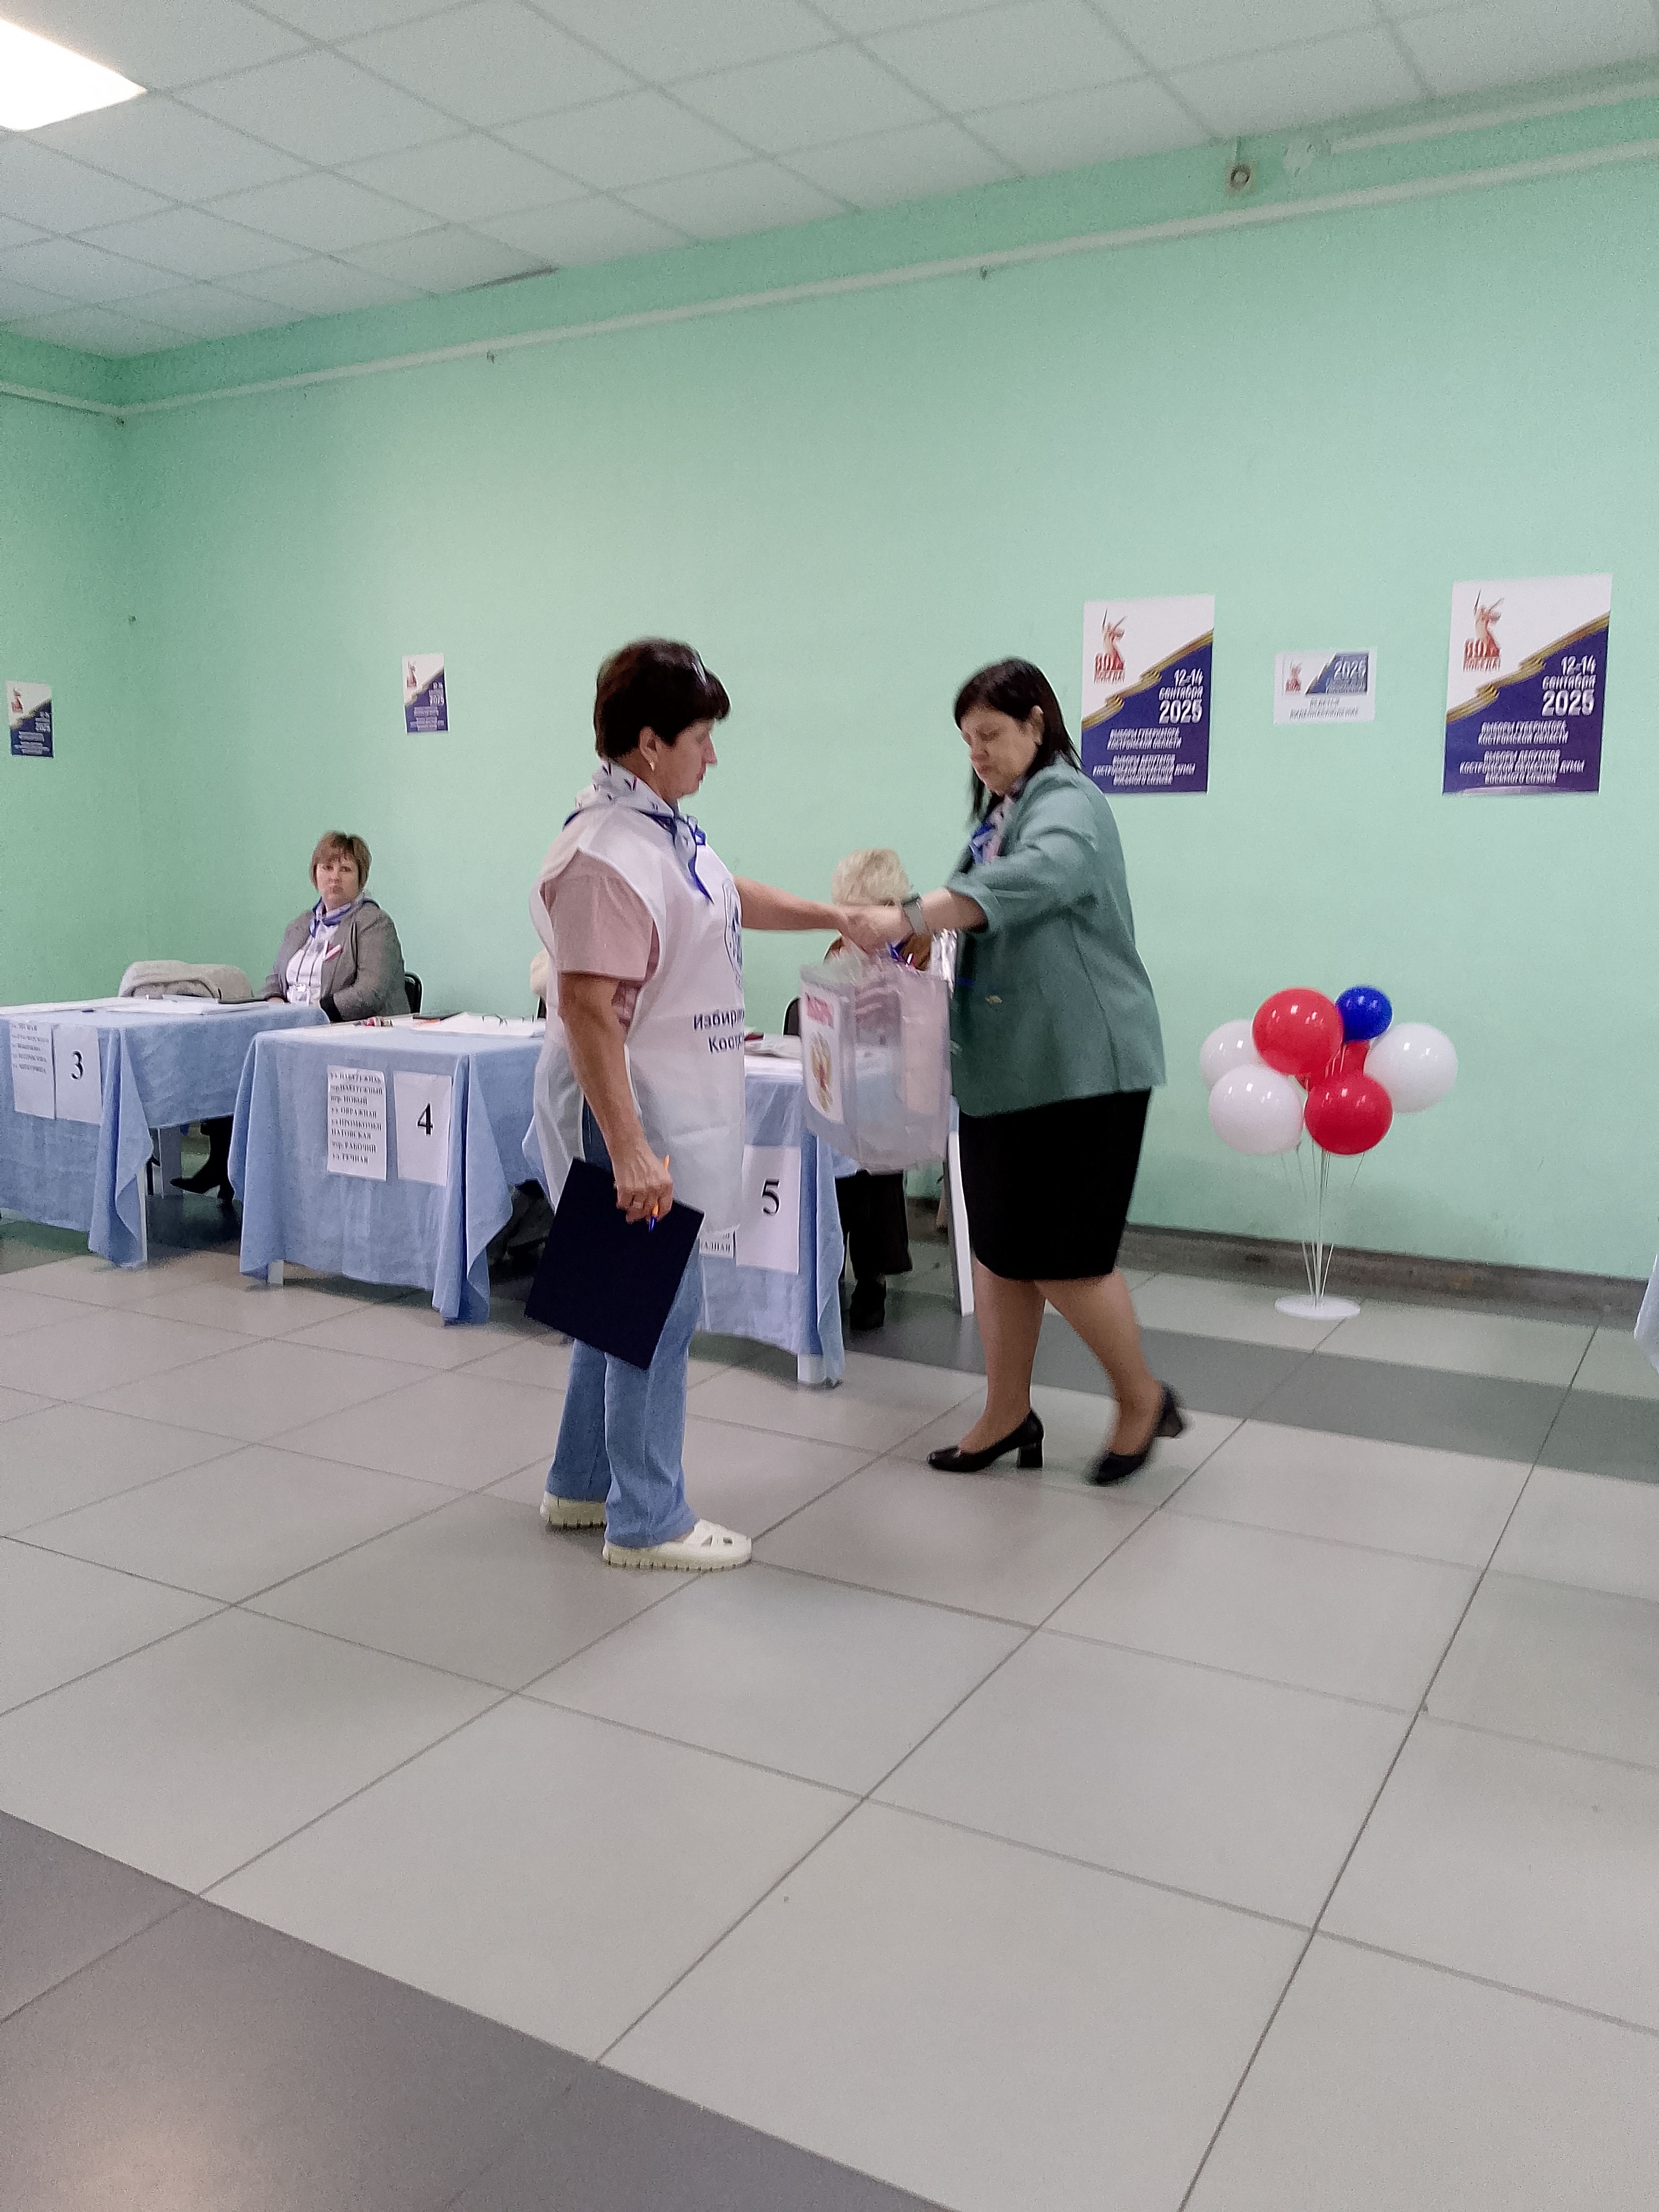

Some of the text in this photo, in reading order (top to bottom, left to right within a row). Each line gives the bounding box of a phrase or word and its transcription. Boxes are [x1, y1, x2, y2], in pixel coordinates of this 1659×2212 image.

[1561, 655, 1596, 675] 12-14
[1174, 668, 1203, 686] 12-14
[1542, 673, 1596, 691] сентября
[1159, 684, 1203, 701] сентября
[1158, 699, 1203, 724] 2025
[1541, 689, 1595, 716] 2025
[1138, 727, 1180, 738] ГУБЕРНАТОРА
[1515, 720, 1567, 733] ГУБЕРНАТОРА
[1174, 763, 1196, 776] ДУМЫ
[1560, 760, 1585, 774] ДУМЫ
[71, 1051, 83, 1079] 3
[417, 1103, 433, 1136] 4
[762, 1178, 780, 1216] 5
